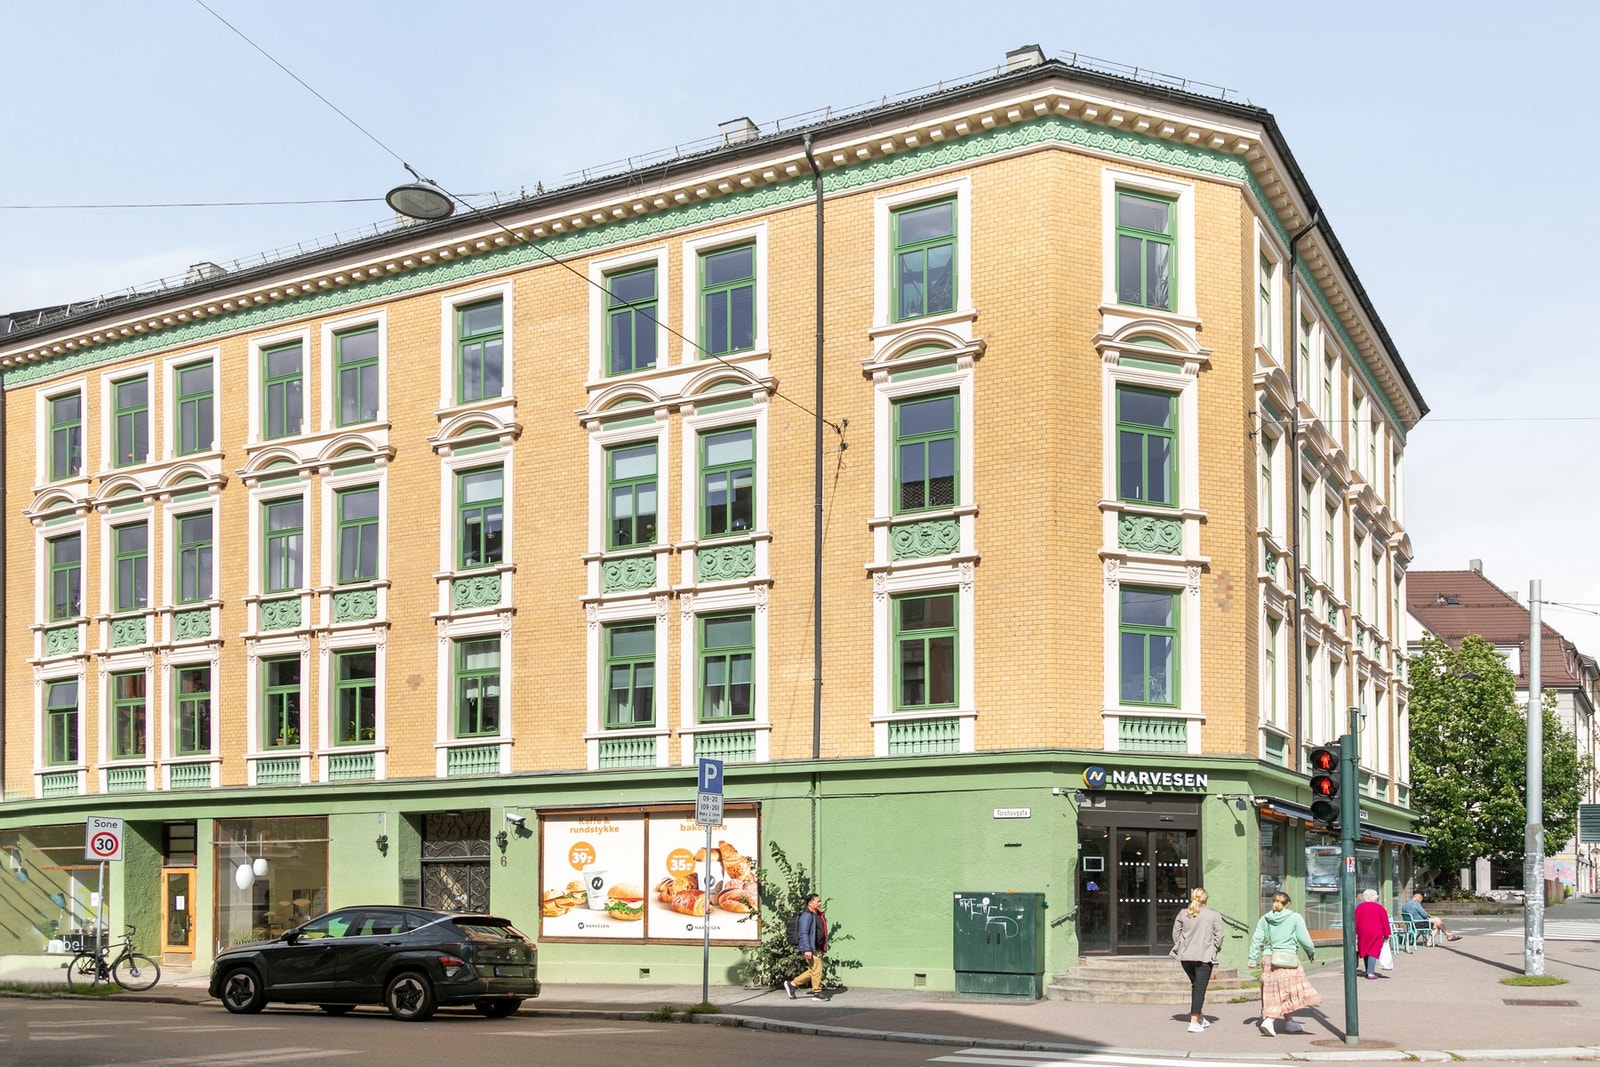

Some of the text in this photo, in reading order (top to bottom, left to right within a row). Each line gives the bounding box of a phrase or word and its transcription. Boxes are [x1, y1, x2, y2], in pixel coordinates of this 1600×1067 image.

[704, 763, 718, 789] P
[1112, 770, 1208, 787] NARVESEN
[702, 795, 719, 803] 09-20
[94, 819, 118, 829] Sone
[578, 816, 610, 825] Kaffe &
[570, 825, 620, 835] rundstykke
[680, 824, 728, 832] bakerare
[96, 838, 114, 851] 30
[500, 855, 508, 867] 6
